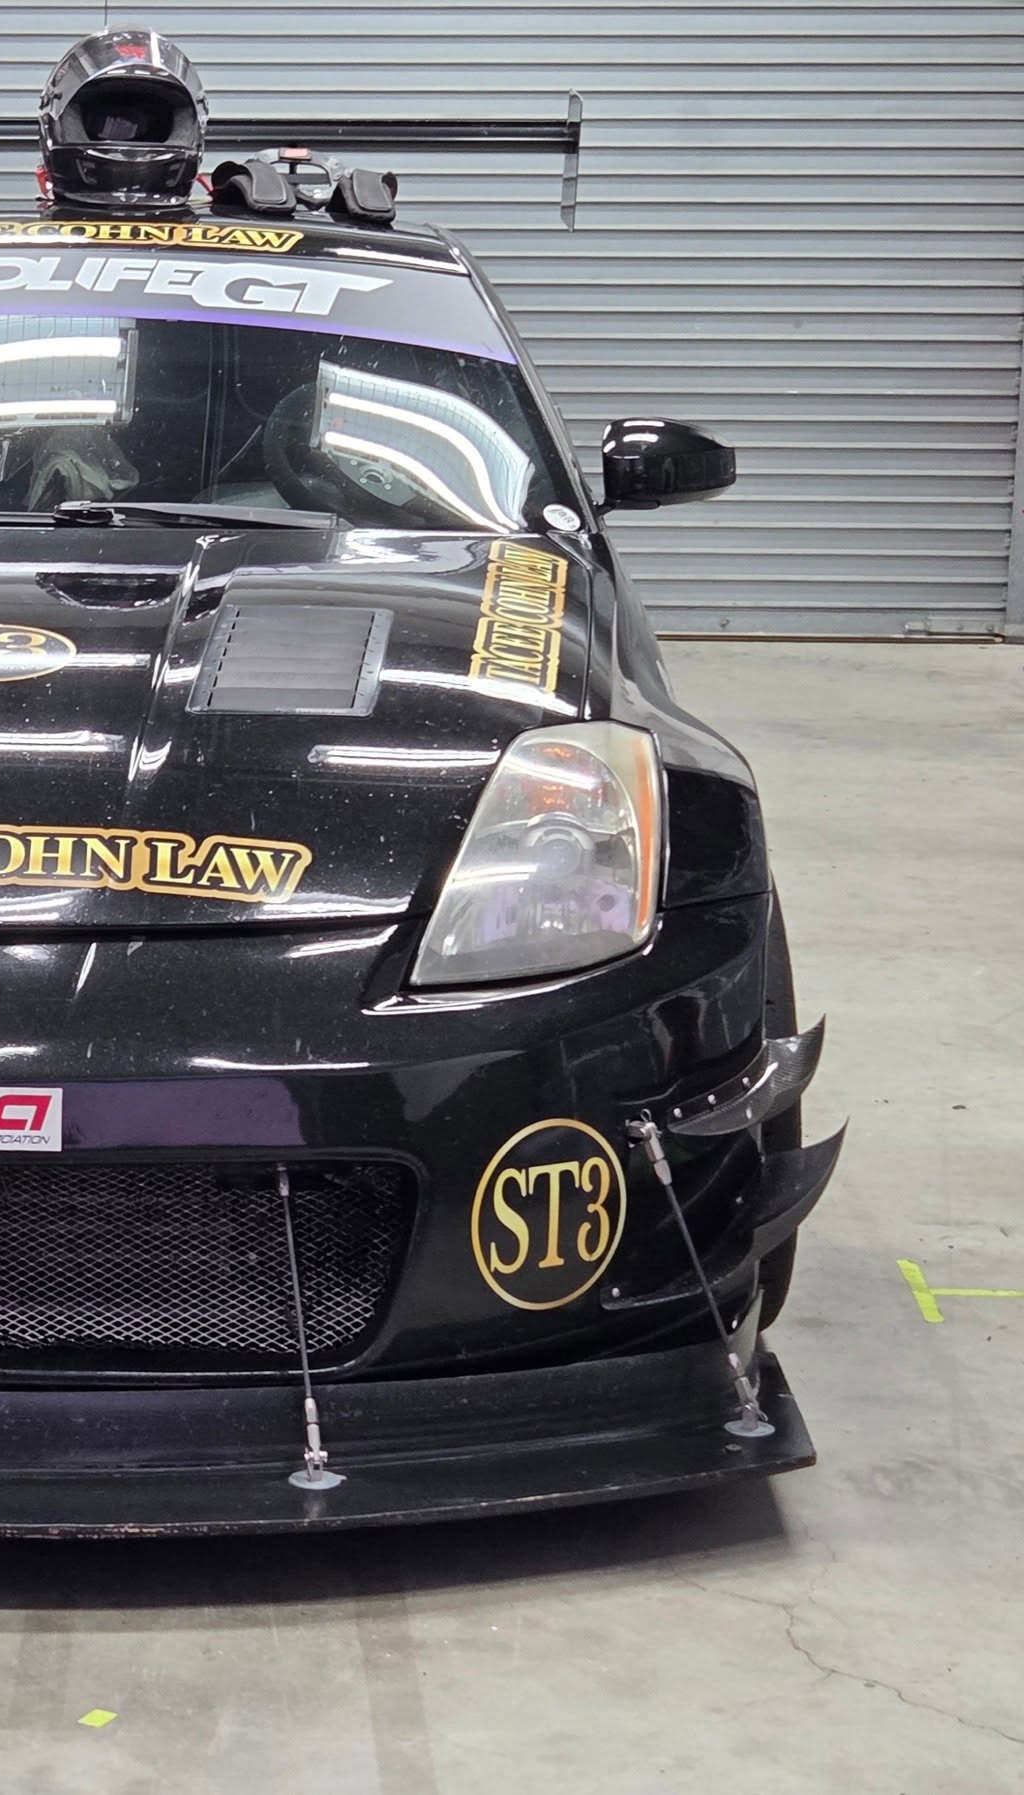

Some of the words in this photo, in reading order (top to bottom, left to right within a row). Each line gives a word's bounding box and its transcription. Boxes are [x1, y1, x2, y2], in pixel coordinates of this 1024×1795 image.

[189, 227, 296, 248] LAW
[192, 262, 395, 316] GT
[501, 545, 555, 582] LAW
[494, 577, 553, 624] COHN
[487, 622, 546, 688] TACEE
[149, 841, 294, 893] LAW
[489, 1156, 611, 1275] ST3
